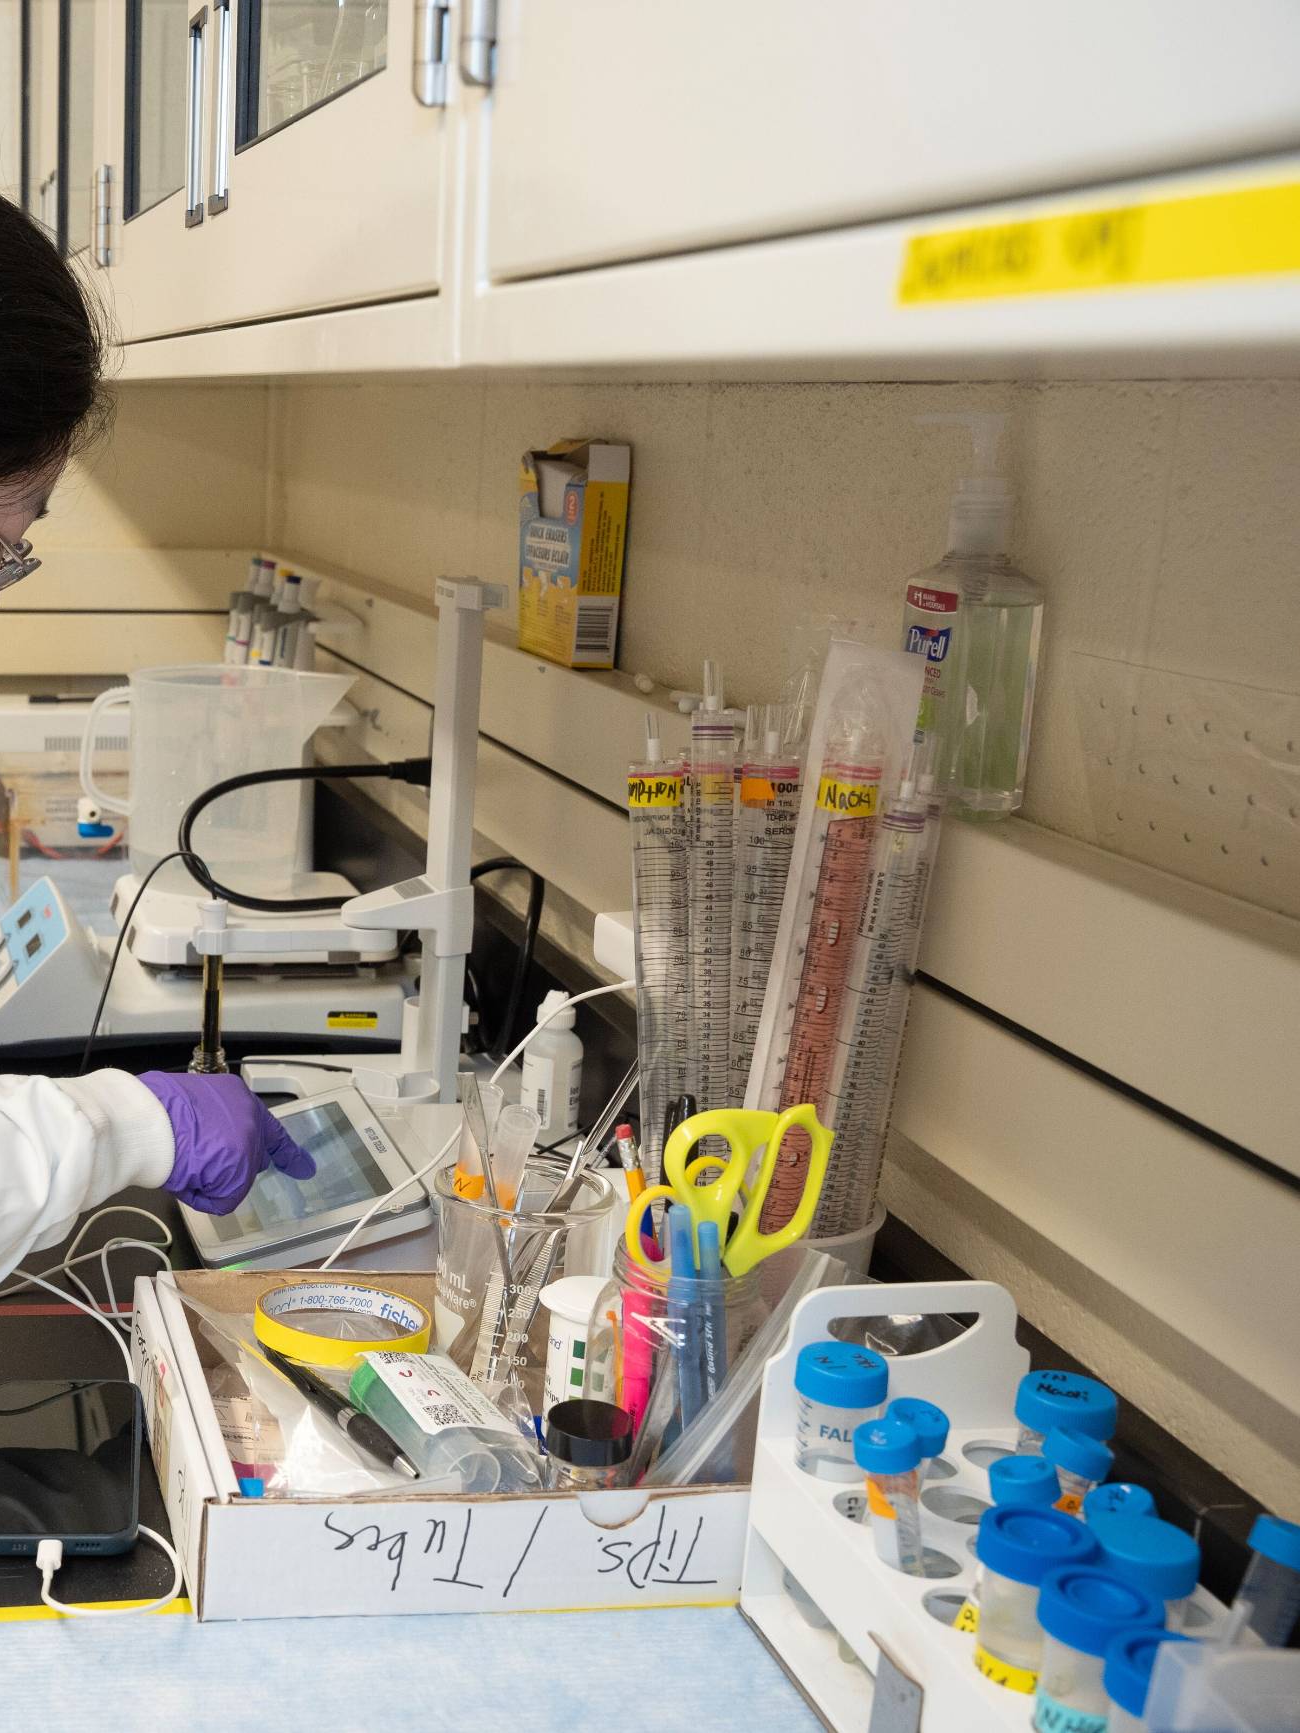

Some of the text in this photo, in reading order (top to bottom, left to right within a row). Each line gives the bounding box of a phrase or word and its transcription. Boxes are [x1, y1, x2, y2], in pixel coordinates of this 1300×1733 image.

[909, 629, 947, 659] Purell
[449, 1273, 471, 1293] mL
[509, 1284, 534, 1296] 300
[300, 1295, 373, 1308] 1-800-766-7000
[819, 1425, 852, 1442] FAL
[325, 1507, 484, 1591] Tubes
